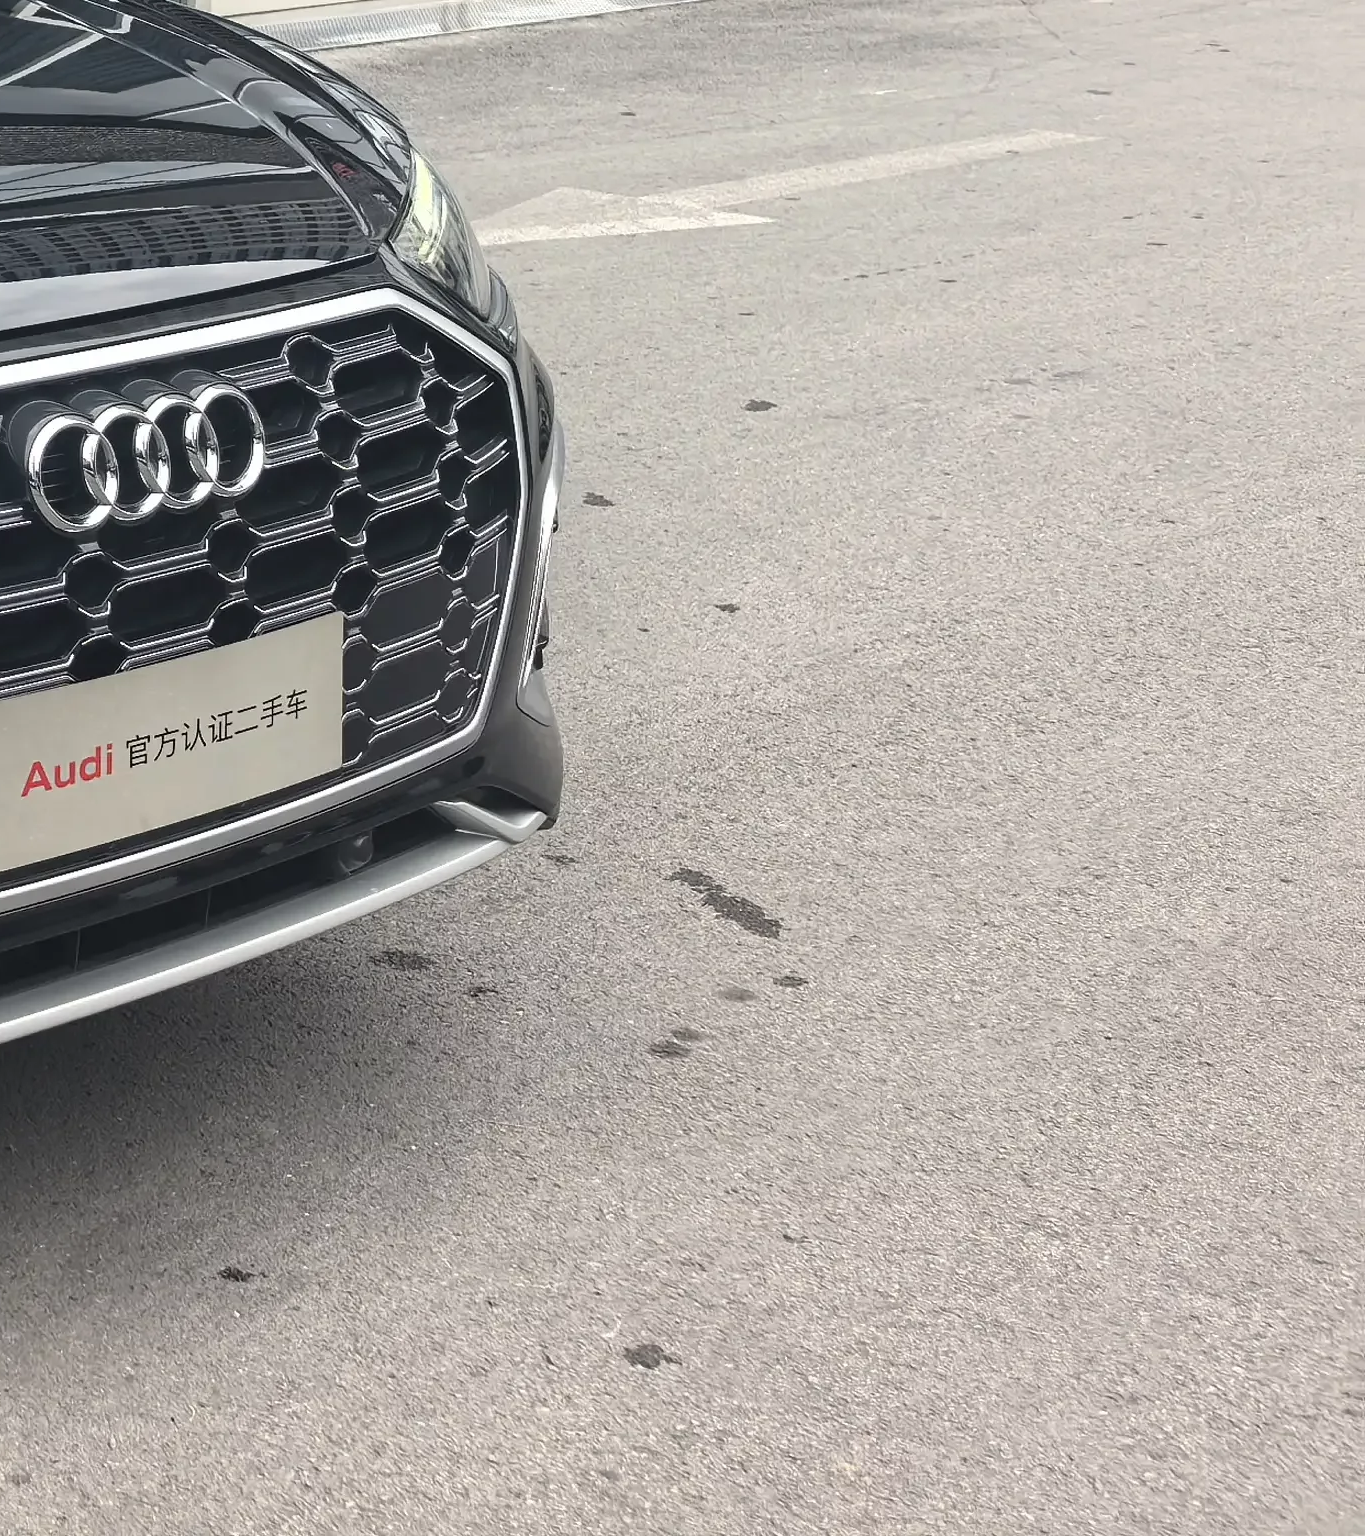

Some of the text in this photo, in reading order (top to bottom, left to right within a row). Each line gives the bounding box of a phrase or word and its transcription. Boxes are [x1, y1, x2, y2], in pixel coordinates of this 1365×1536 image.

[21, 689, 308, 798] Audi 官方认证二手车
